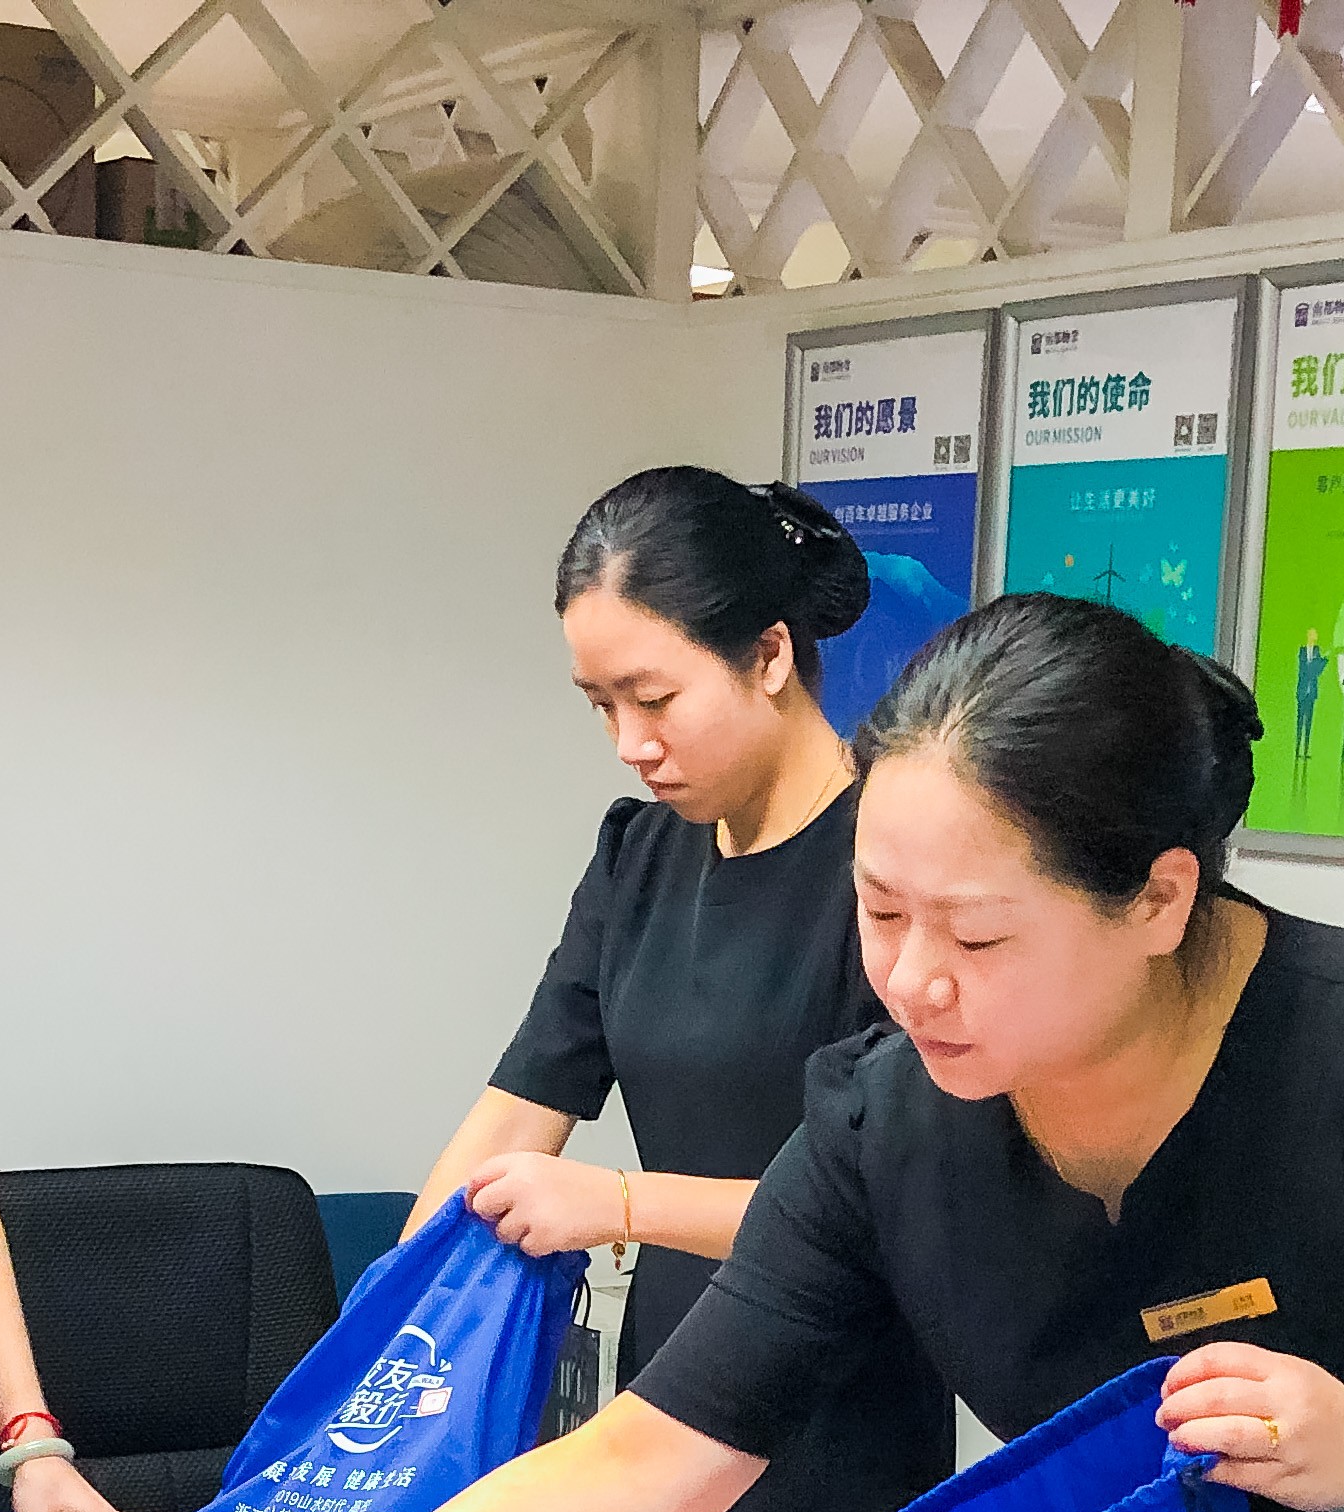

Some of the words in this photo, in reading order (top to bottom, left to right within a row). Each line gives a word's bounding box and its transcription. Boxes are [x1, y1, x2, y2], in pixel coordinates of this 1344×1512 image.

[1028, 370, 1152, 420] 我们的使命
[813, 395, 918, 440] 我们的愿景
[1287, 409, 1320, 429] OUR
[1026, 428, 1051, 446] OUR
[1053, 425, 1103, 445] MISSION
[810, 448, 831, 465] OUR
[832, 445, 865, 463] VISION
